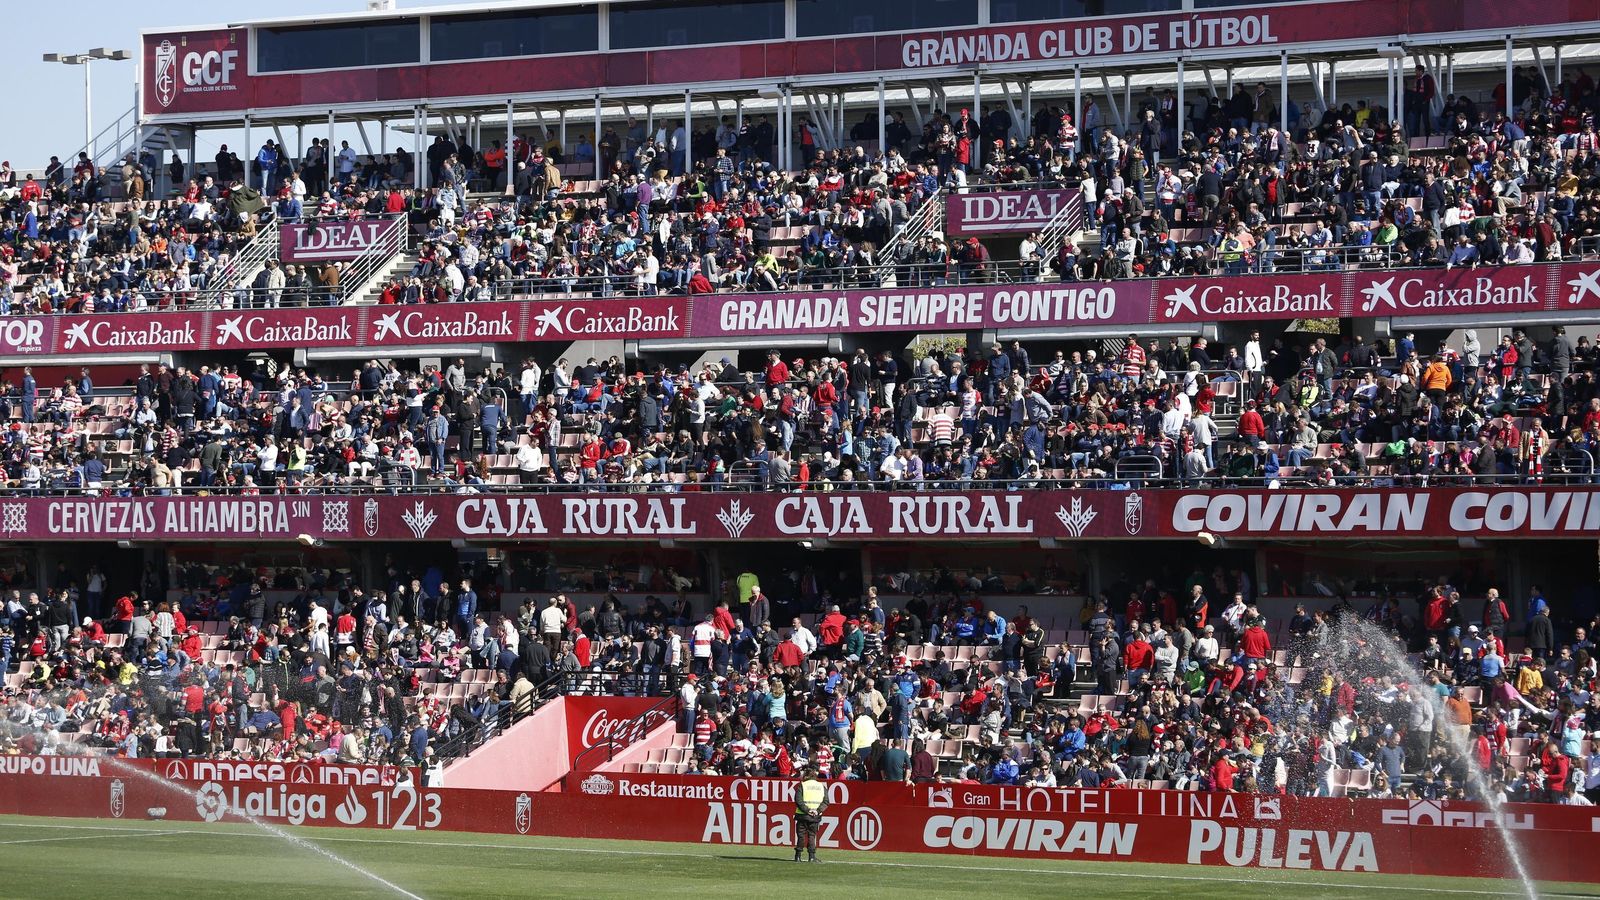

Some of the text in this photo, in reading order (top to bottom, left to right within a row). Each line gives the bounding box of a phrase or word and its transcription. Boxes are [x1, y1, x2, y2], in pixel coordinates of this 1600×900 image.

[902, 15, 1279, 67] GRANADA CLUB DE FÚTBOL
[183, 50, 239, 86] GCF
[962, 194, 1069, 222] IDEAL
[294, 224, 387, 250] IDEAL
[1200, 282, 1334, 314] CaixaBank
[1399, 275, 1539, 308] CaixaBank
[403, 311, 513, 338] CaixaBank
[565, 305, 680, 334] CaixaBank
[720, 287, 1117, 331] GRANADA SIEMPRE CONTIGO
[92, 319, 196, 347] CaixaBank
[245, 315, 352, 342] CaixaBank
[49, 500, 311, 533] CERVEZAS ALHAMBRA SIN
[456, 498, 697, 537] CAJA RURAL
[774, 495, 1034, 537] CAJA RURAL
[1172, 492, 1431, 532] COVIRAN
[50, 757, 101, 777] LUNA
[233, 784, 326, 825] LaLiga
[619, 779, 849, 804] Restaurante CHIKO
[963, 791, 991, 806] Gran
[701, 802, 839, 848] Alliaz
[923, 815, 1138, 856] COVIRAN
[1187, 819, 1379, 872] PULEVA
